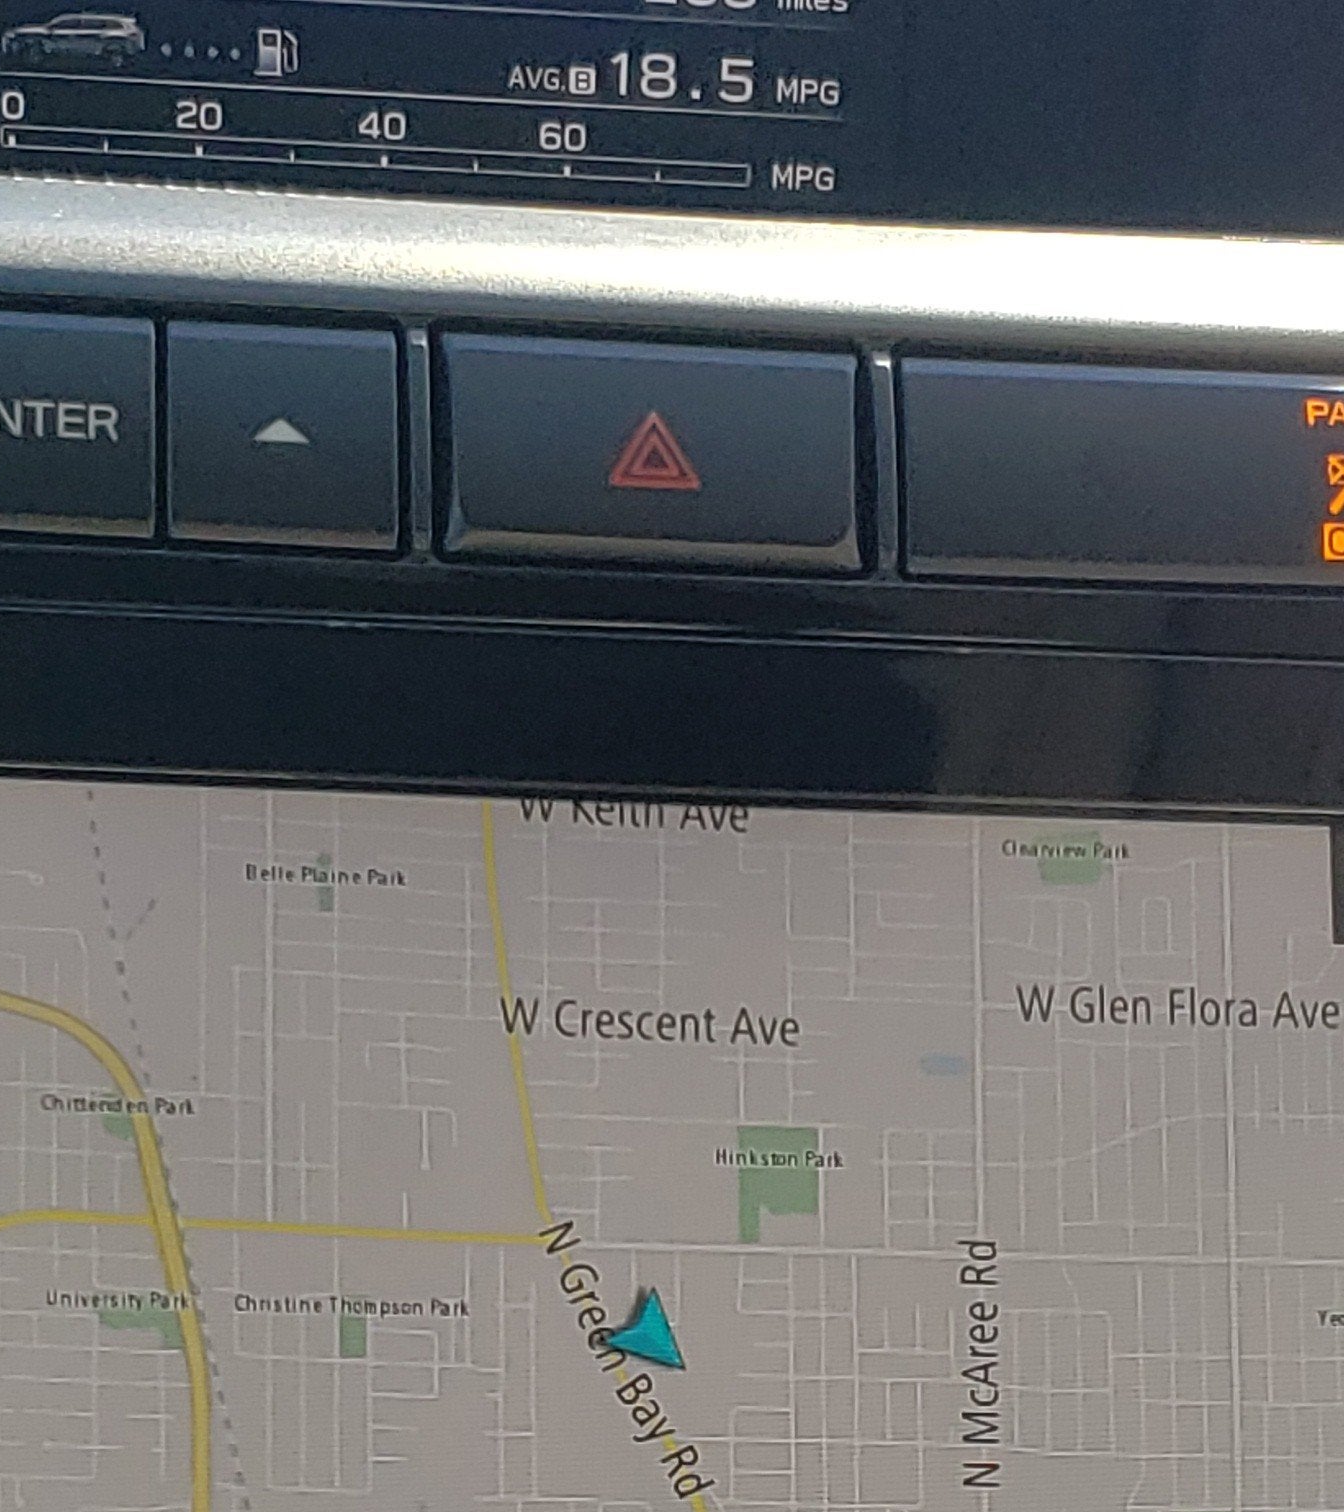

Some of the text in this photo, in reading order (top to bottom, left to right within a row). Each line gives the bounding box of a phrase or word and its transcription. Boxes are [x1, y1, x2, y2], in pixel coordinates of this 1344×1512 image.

[610, 51, 755, 103] 18.5
[777, 77, 841, 107] MPG
[0, 90, 26, 122] 0
[175, 99, 224, 132] 20
[358, 110, 407, 142] 40
[538, 122, 588, 153] 60
[771, 163, 837, 193] MPG
[679, 804, 751, 834] Ave
[1093, 841, 1131, 860] Park
[245, 863, 407, 888] Belle Plaine Park
[499, 996, 801, 1046] W Crescent Ave
[1016, 985, 1341, 1030] W Glen Flora Ave
[155, 1097, 196, 1116] Park
[714, 1148, 844, 1169] Hinkston Park
[45, 1290, 192, 1311] University Park
[233, 1293, 471, 1318] Christine Thompson Park
[538, 1220, 716, 1500] N Green Bay Rd
[956, 1240, 1001, 1488] N McAree Rd
